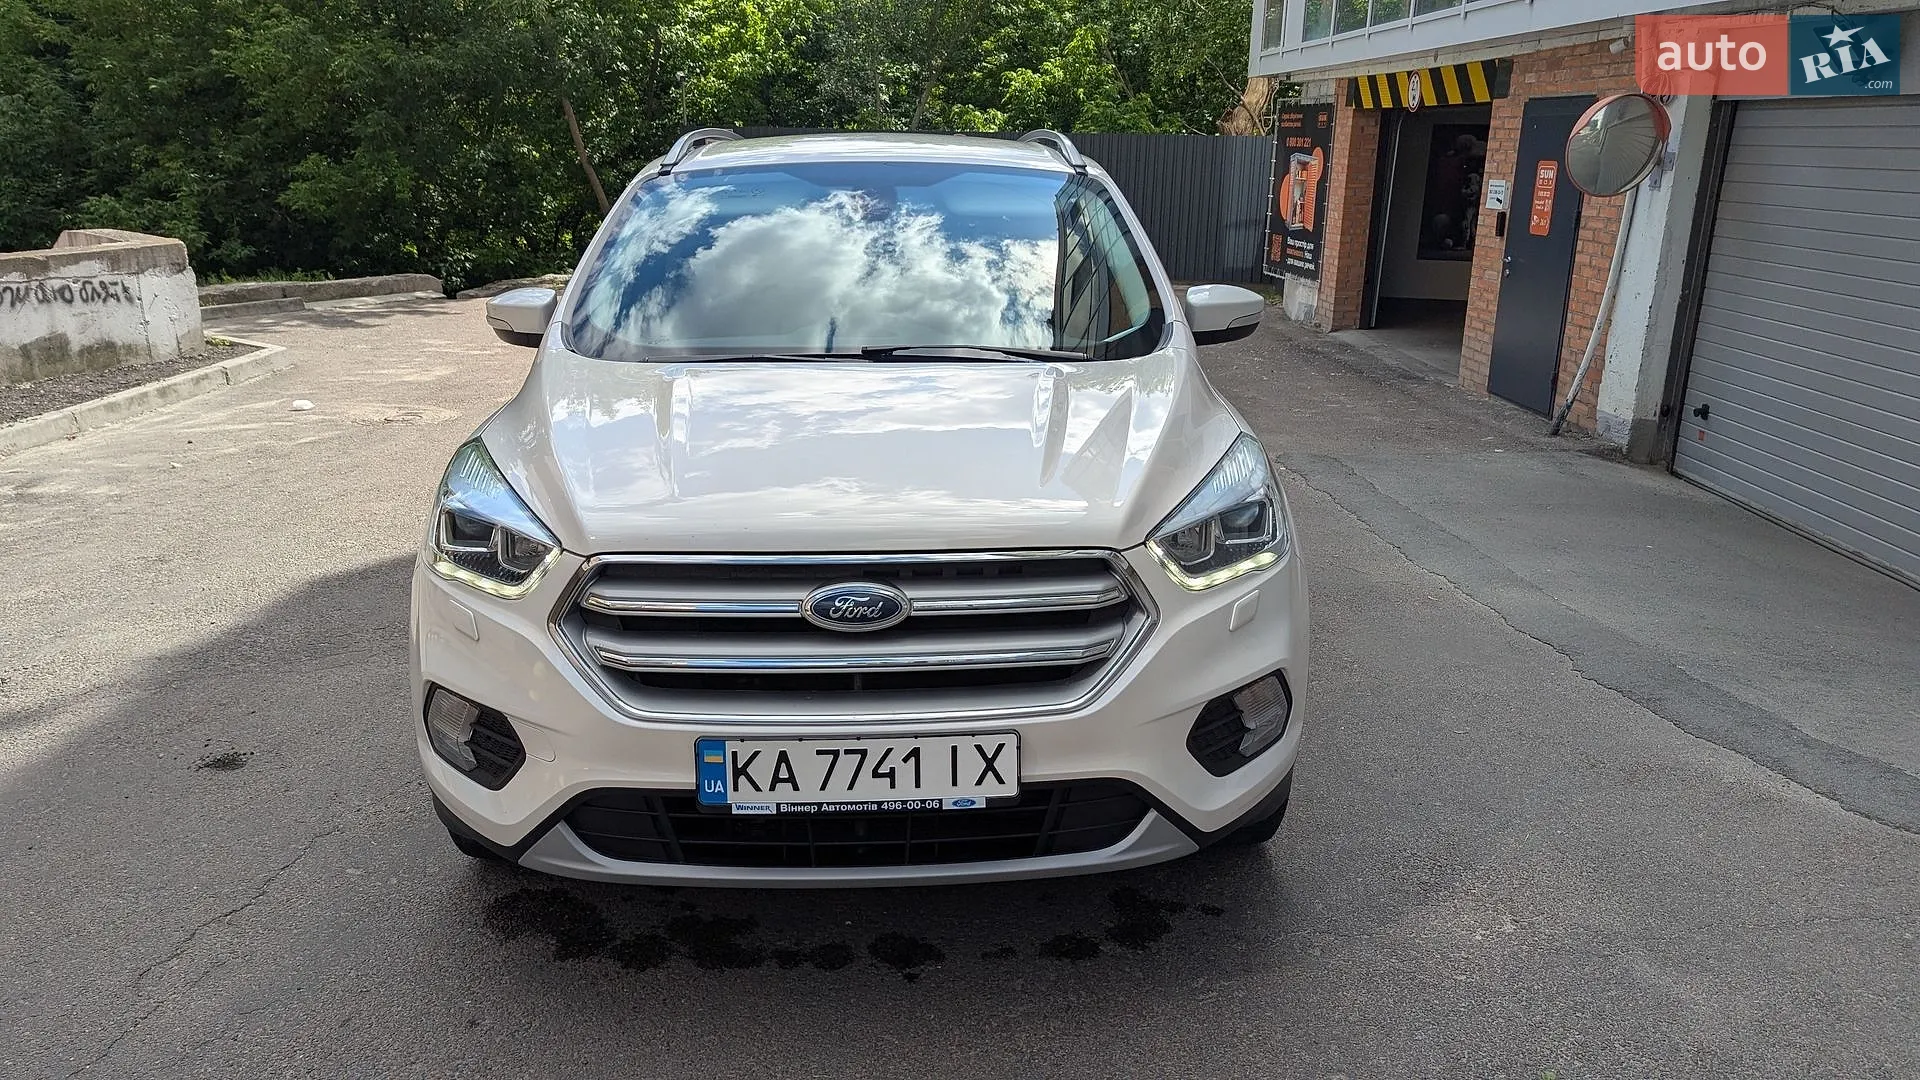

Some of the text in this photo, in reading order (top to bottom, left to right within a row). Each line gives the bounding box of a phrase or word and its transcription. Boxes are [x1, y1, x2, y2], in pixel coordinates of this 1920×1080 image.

[1540, 169, 1553, 178] SUN
[829, 595, 884, 618] Ford
[731, 743, 1006, 792] KA 7741 IX
[704, 780, 725, 793] UA
[780, 800, 940, 814] Віннер Автомотів 496-00-06
